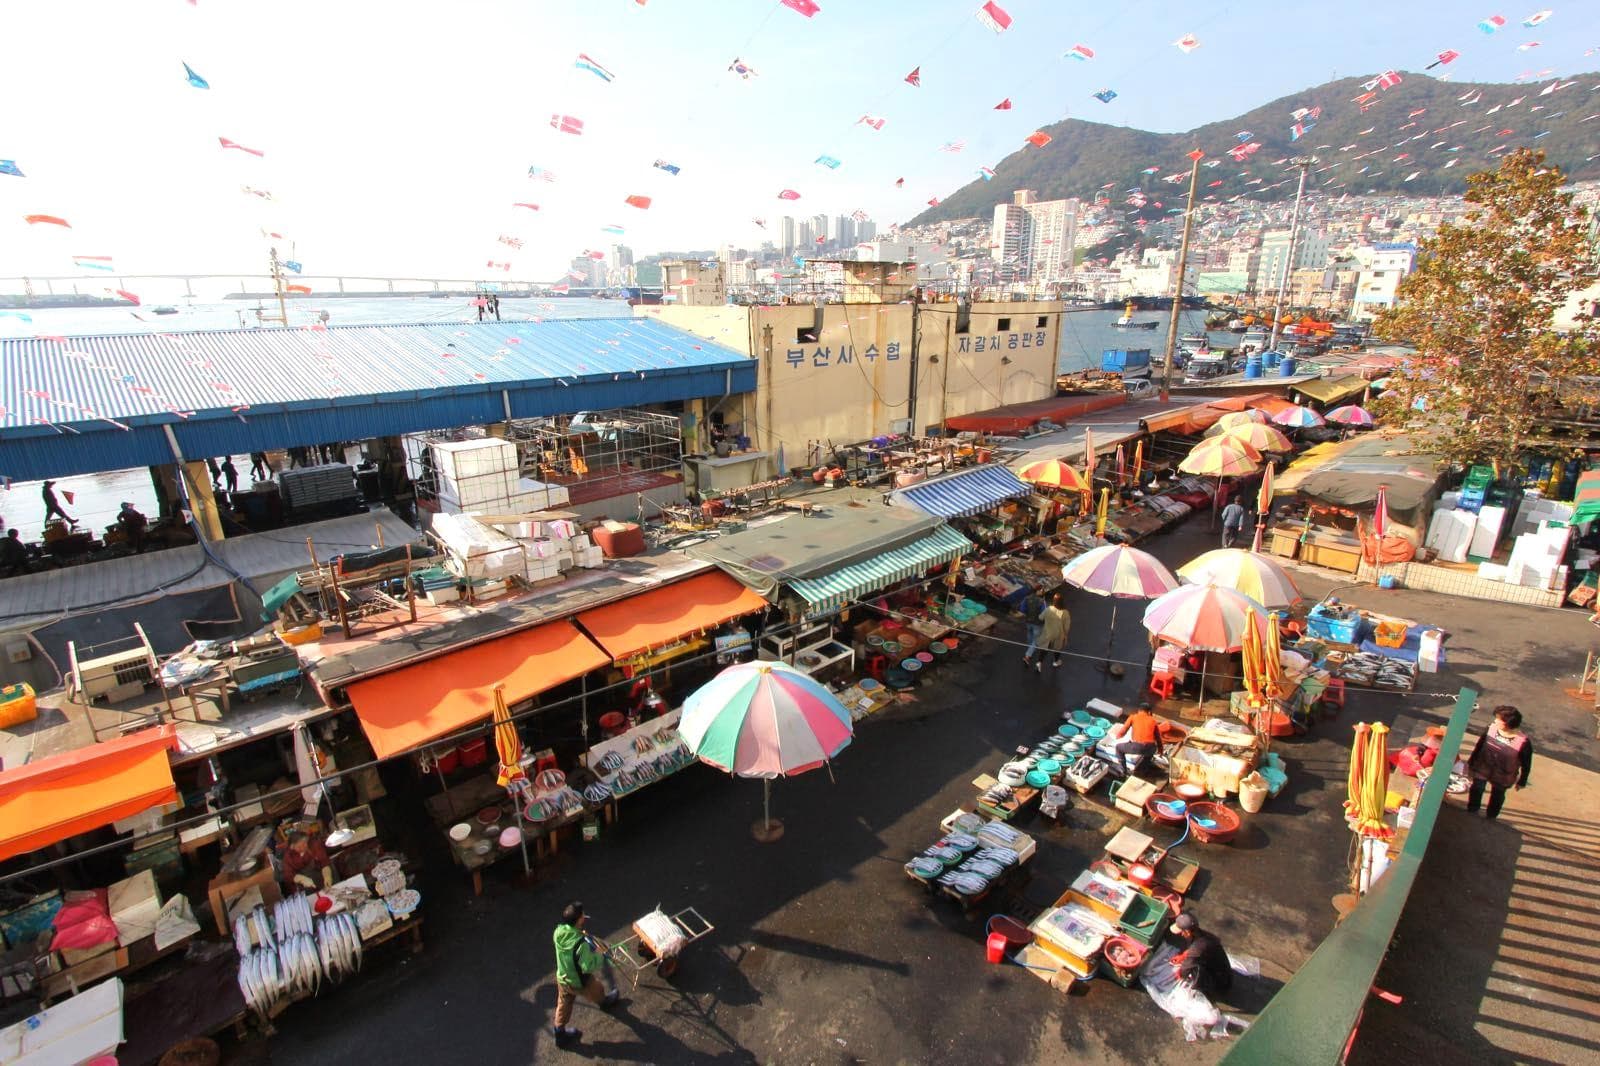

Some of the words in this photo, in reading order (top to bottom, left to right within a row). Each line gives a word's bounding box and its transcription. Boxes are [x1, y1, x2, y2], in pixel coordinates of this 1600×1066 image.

[958, 335, 1001, 354] 자갈치
[1008, 331, 1046, 350] 공판장
[786, 345, 853, 369] 부산시
[864, 342, 901, 361] 수협
